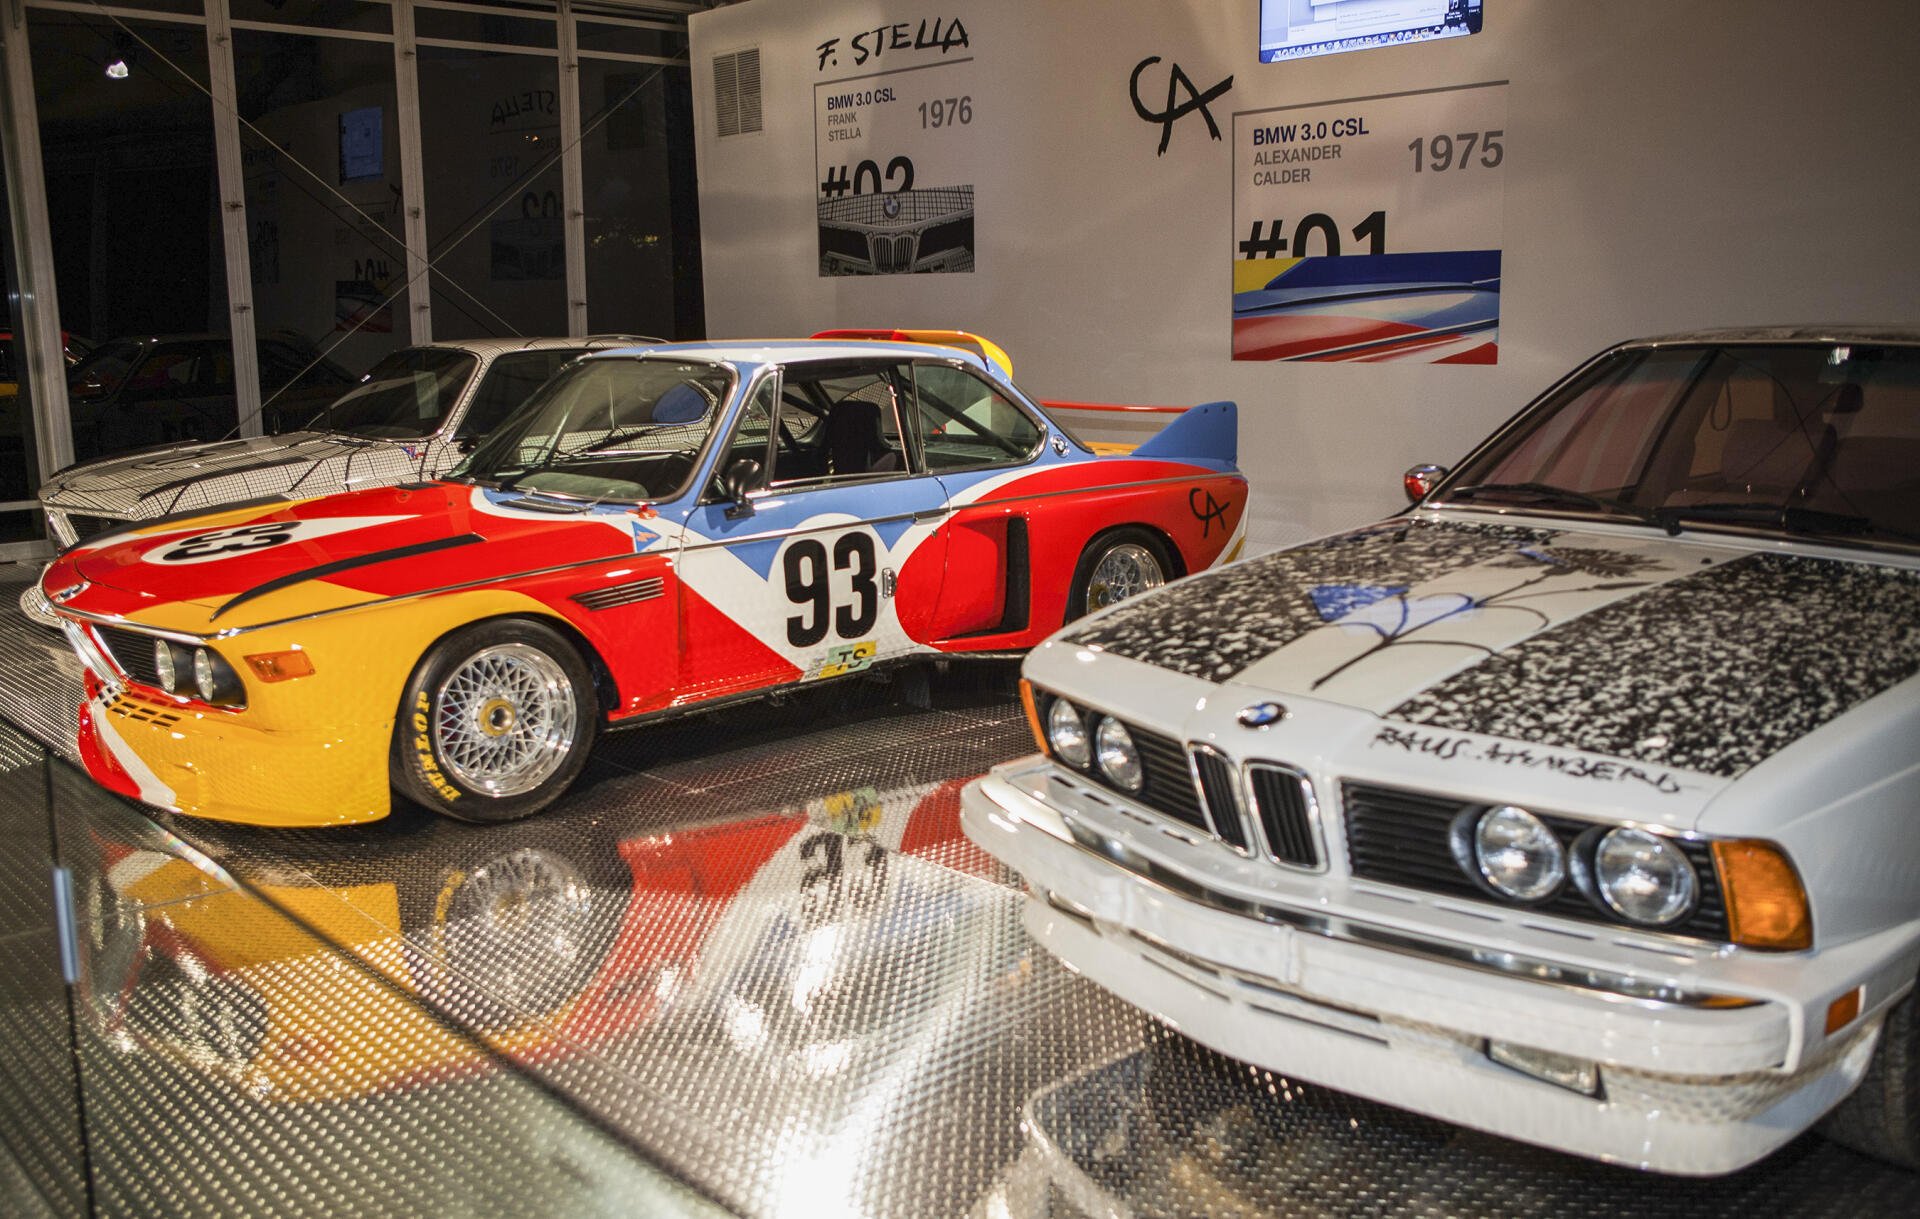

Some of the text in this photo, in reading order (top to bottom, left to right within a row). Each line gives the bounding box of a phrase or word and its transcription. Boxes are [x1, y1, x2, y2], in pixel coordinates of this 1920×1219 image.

[816, 16, 969, 72] F. STELLA
[827, 87, 896, 111] BMW 3.0 CSL
[828, 112, 857, 127] FRANK
[918, 95, 973, 129] 1976
[828, 127, 861, 143] STELLA
[1253, 117, 1369, 146] BMW 3.0 CSL
[1253, 144, 1342, 166] ALEXANDER
[1407, 130, 1504, 173] 1975
[1253, 167, 1311, 187] CALDER
[783, 531, 878, 648] 93
[837, 648, 867, 671] TS
